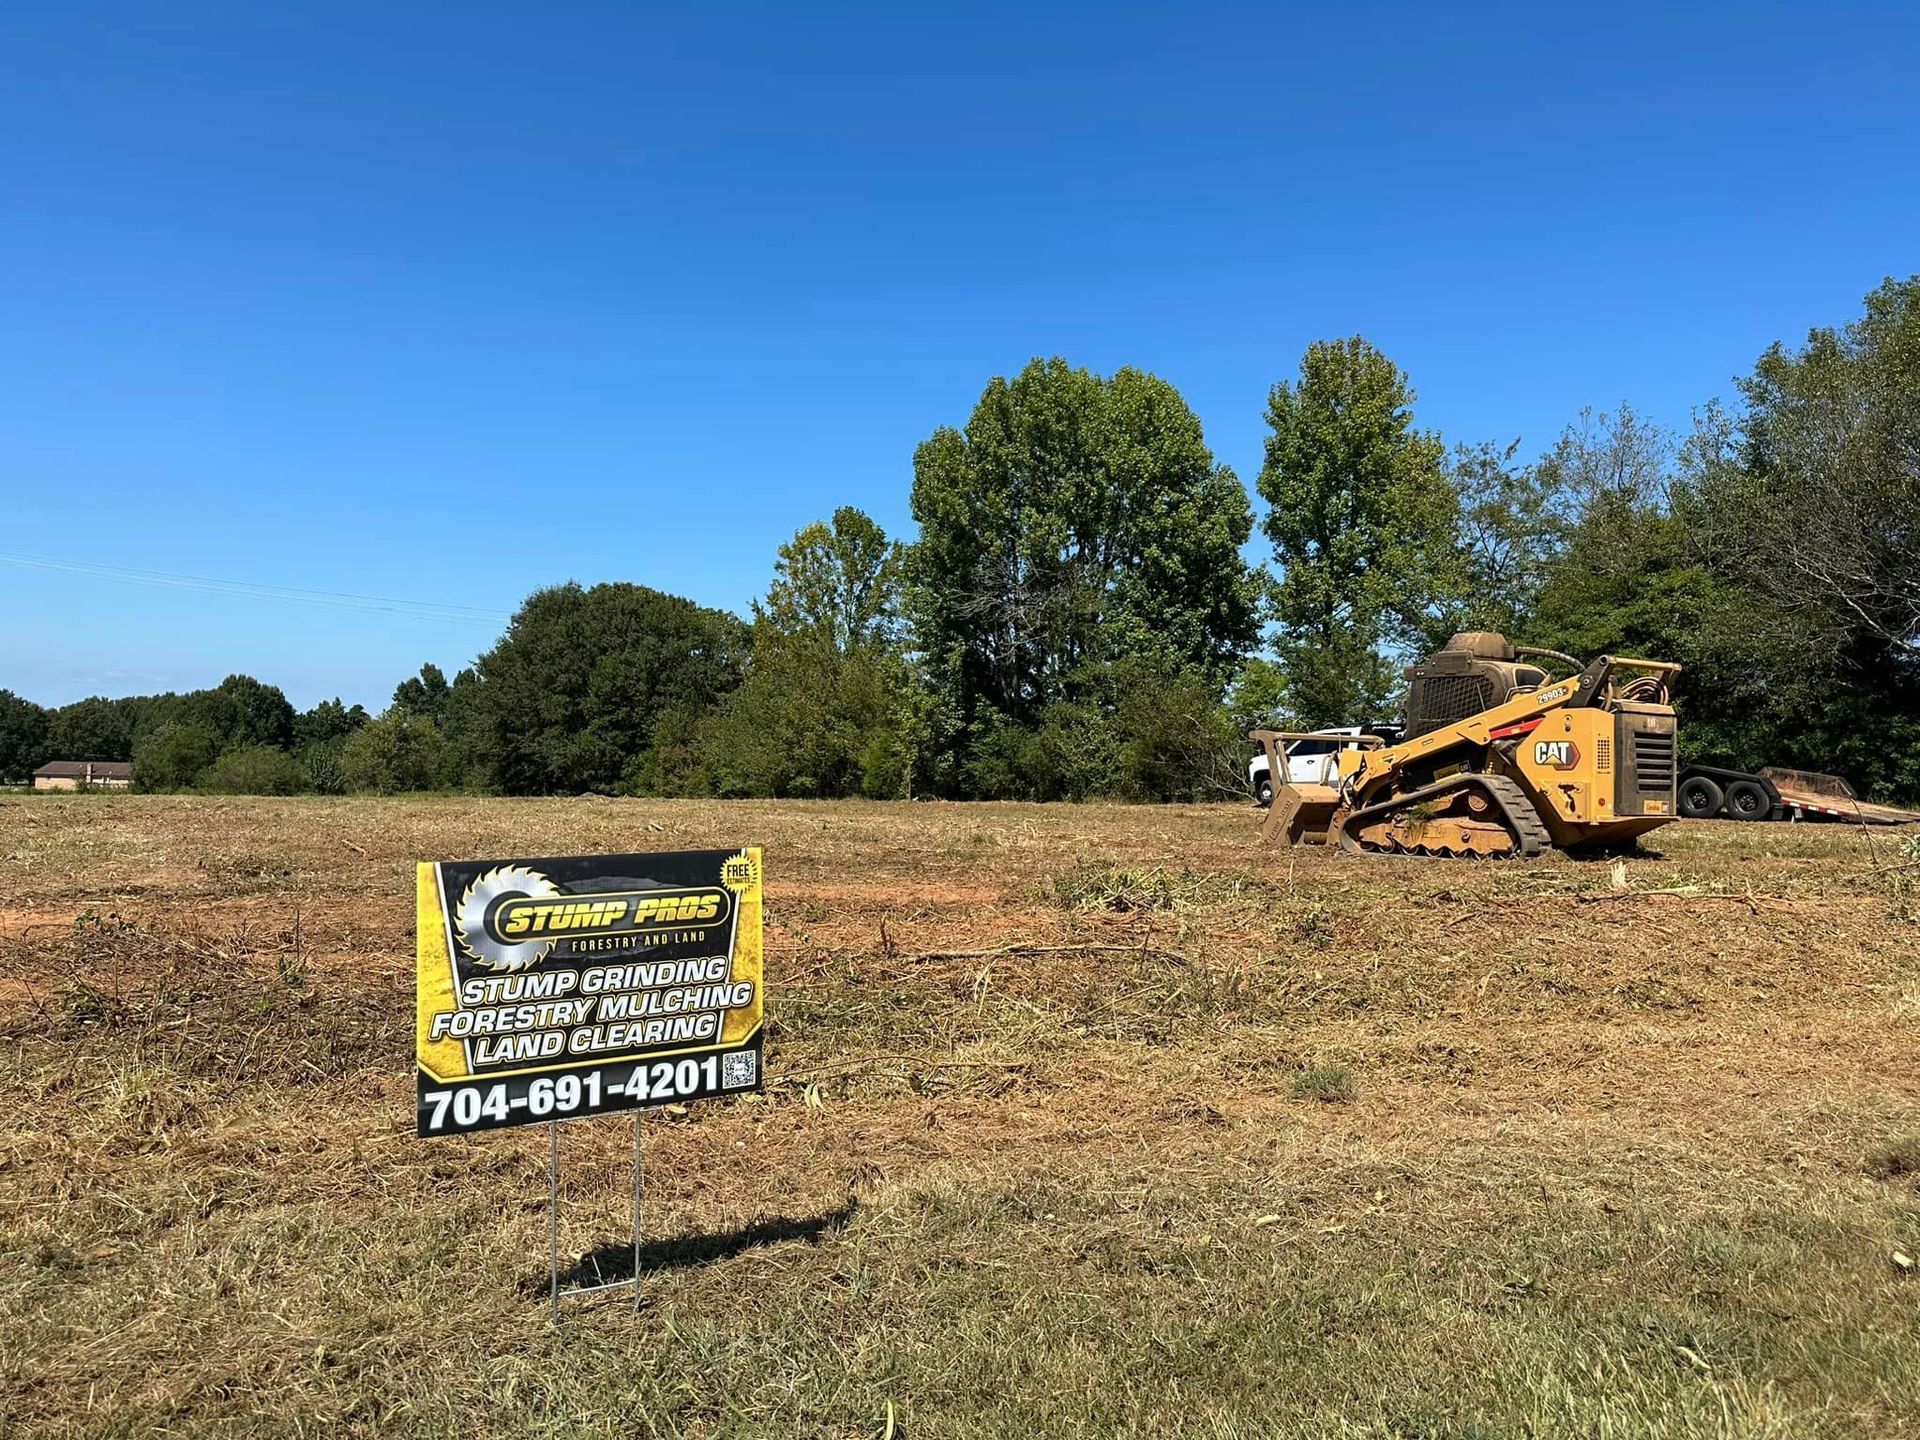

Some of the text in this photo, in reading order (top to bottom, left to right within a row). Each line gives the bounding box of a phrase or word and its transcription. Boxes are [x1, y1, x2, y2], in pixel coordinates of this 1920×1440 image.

[1535, 741, 1570, 765] CAT
[727, 863, 750, 877] FREE
[505, 895, 720, 933] STUMP PROS
[572, 931, 705, 952] FORESTRY AND LAND
[462, 957, 726, 1004] STUMP GRINDING
[431, 982, 751, 1039] FORESTRY MULCHING
[475, 1014, 716, 1063] LAND CLEARING
[425, 1055, 718, 1130] 704-691-4201
